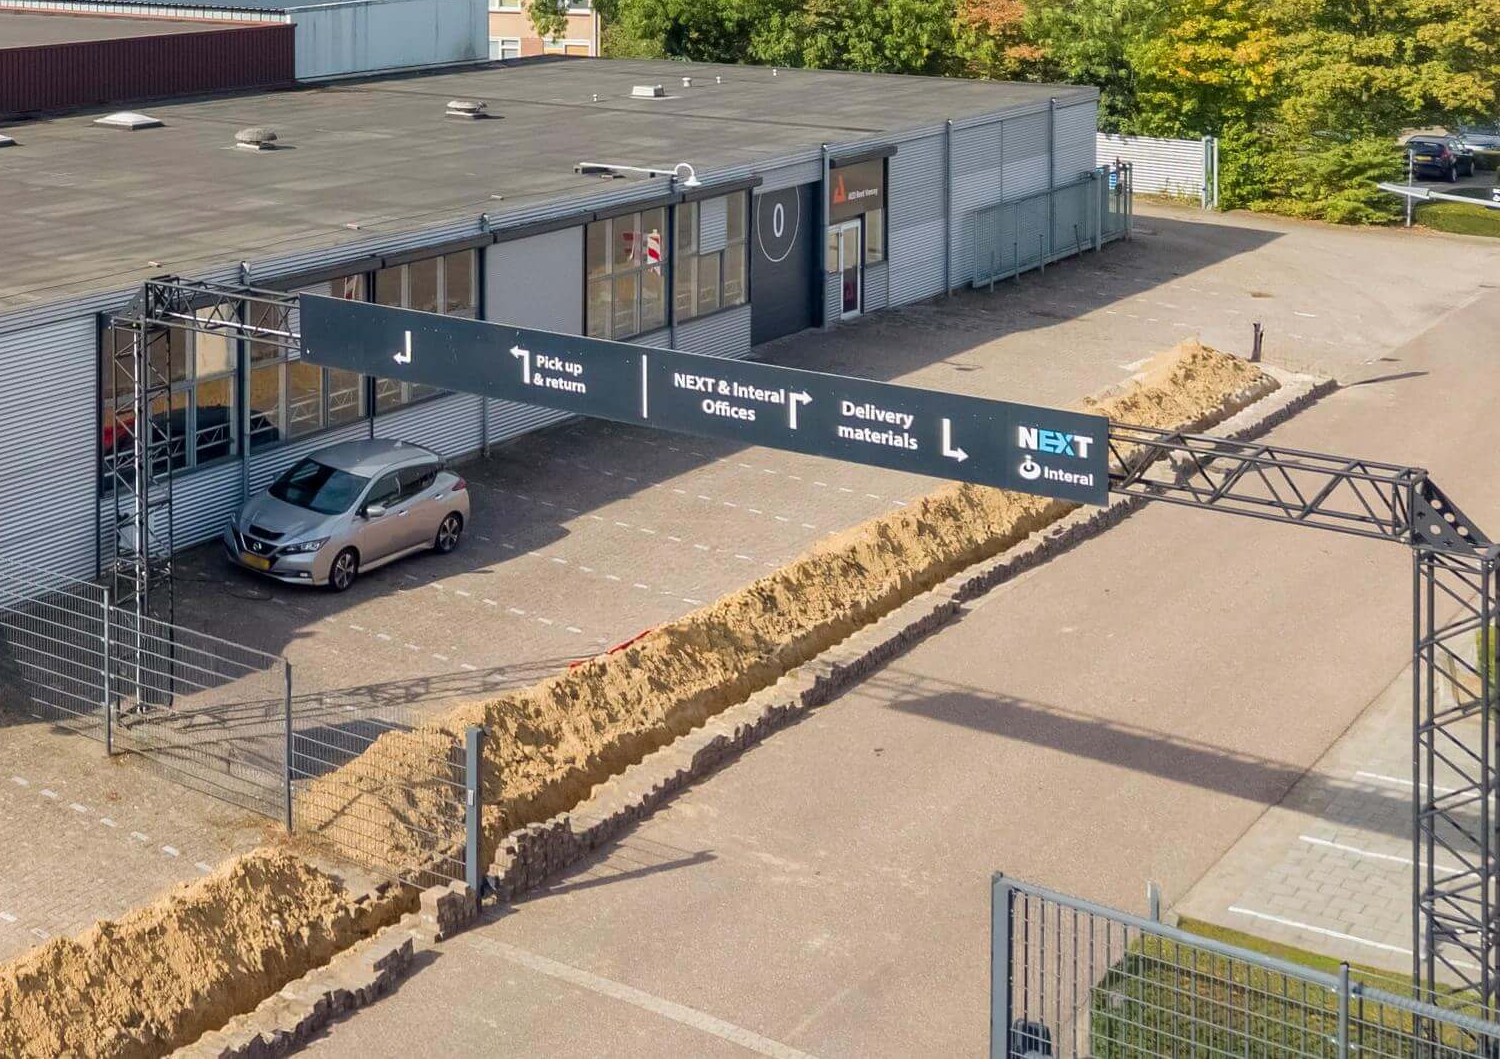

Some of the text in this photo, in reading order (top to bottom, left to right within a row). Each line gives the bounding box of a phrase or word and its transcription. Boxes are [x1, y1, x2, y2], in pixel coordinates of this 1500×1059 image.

[536, 354, 583, 377] Pick up
[533, 372, 587, 394] & return
[673, 372, 785, 404] NEXT & Interal
[701, 399, 756, 421] Offices
[841, 400, 915, 430] Delivery
[837, 425, 919, 451] materials
[1018, 425, 1094, 459] NEXT
[1043, 466, 1094, 487] Interal
